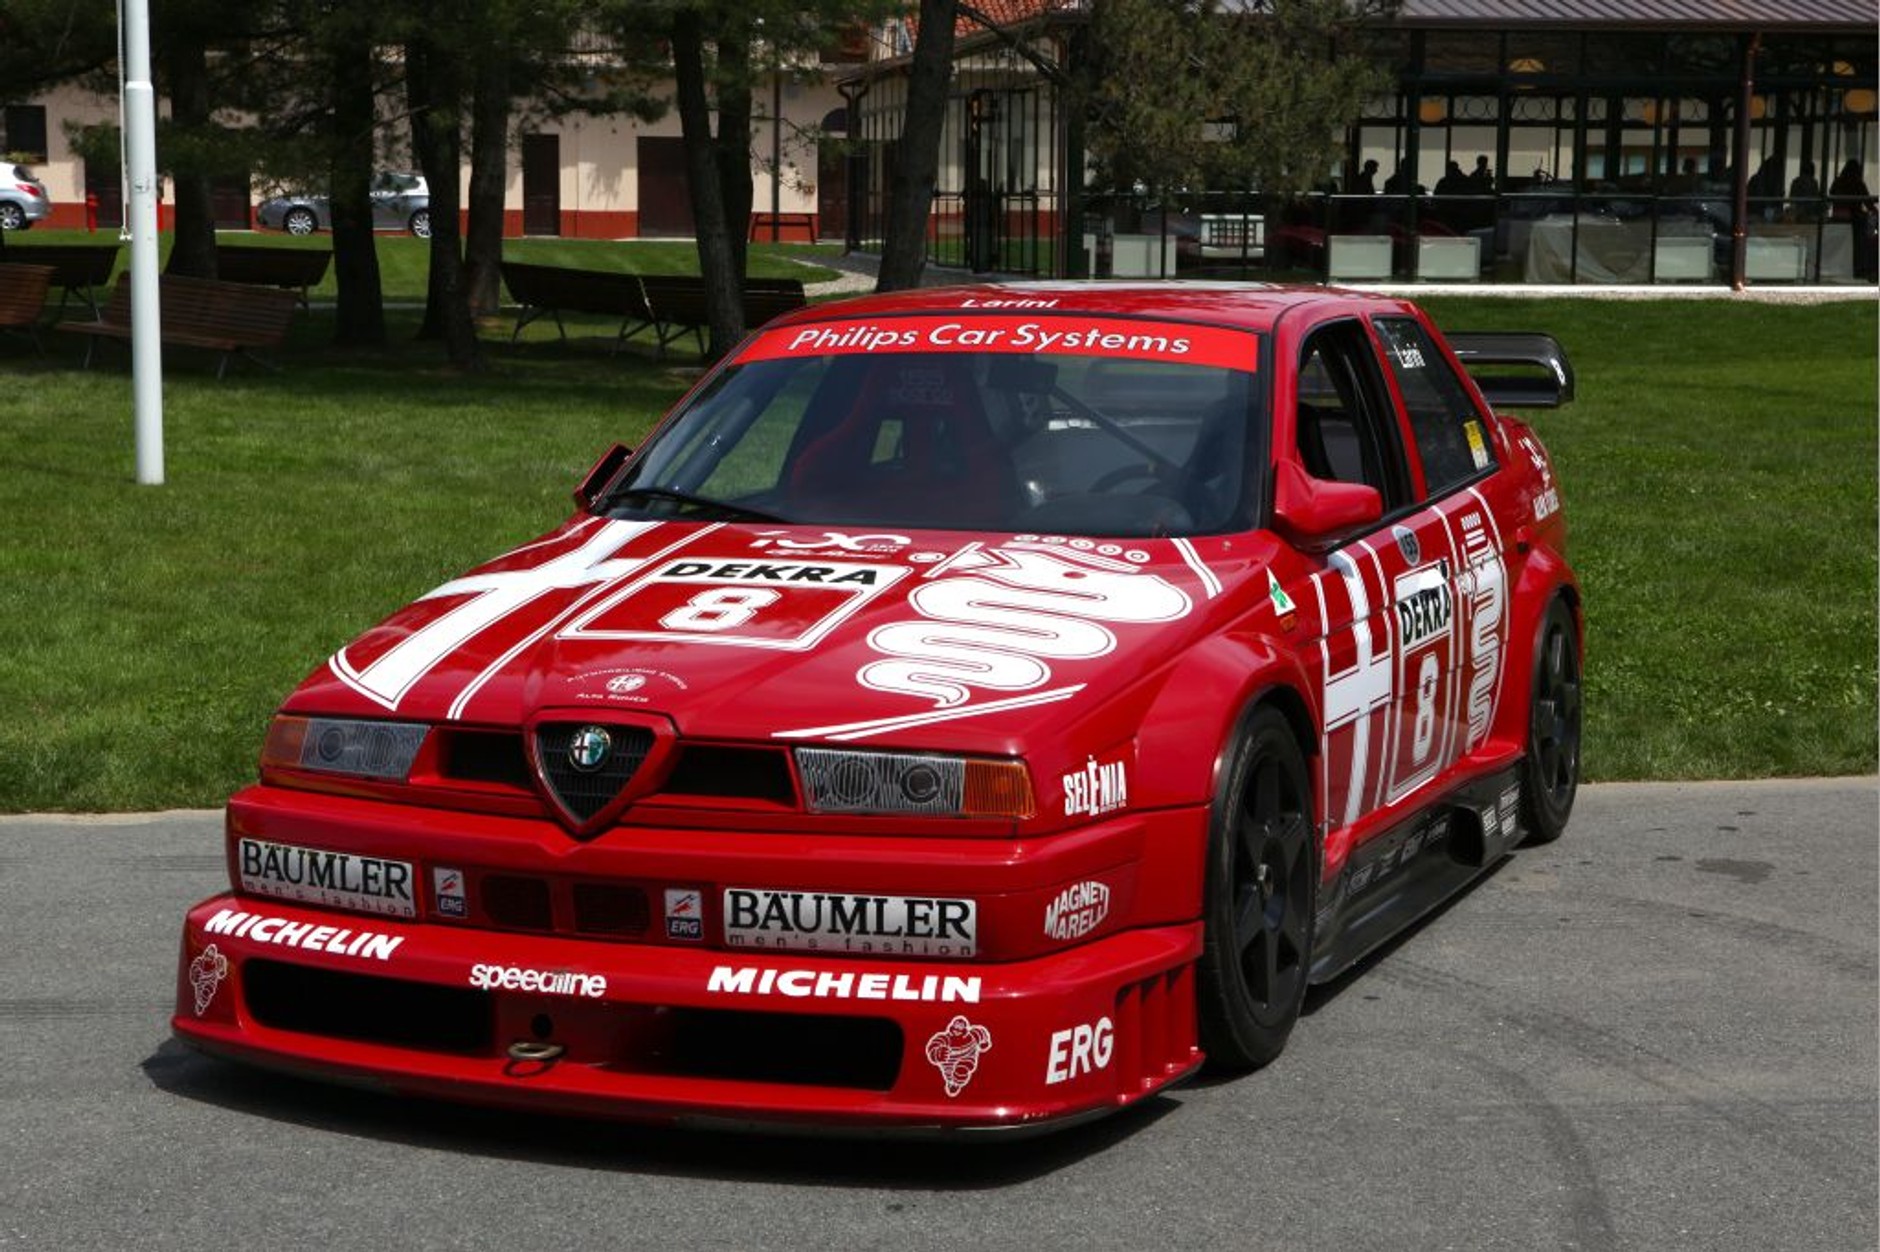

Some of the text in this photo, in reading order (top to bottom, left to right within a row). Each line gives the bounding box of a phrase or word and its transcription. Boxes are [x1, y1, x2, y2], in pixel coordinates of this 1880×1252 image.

[960, 299, 1059, 308] Larini
[788, 323, 1191, 354] Philips Car Systems
[660, 562, 878, 586] DEKRA
[658, 587, 782, 632] 8
[1413, 651, 1440, 767] 8
[242, 840, 411, 901] BÄUMLER
[320, 890, 413, 917] fashion
[728, 890, 972, 940] BÄUMLER
[204, 909, 404, 960] MICHELIN
[669, 918, 700, 935] ERG
[729, 933, 972, 957] men's fashion
[707, 966, 982, 1003] MICHELIN
[1046, 1016, 1114, 1085] ERG
